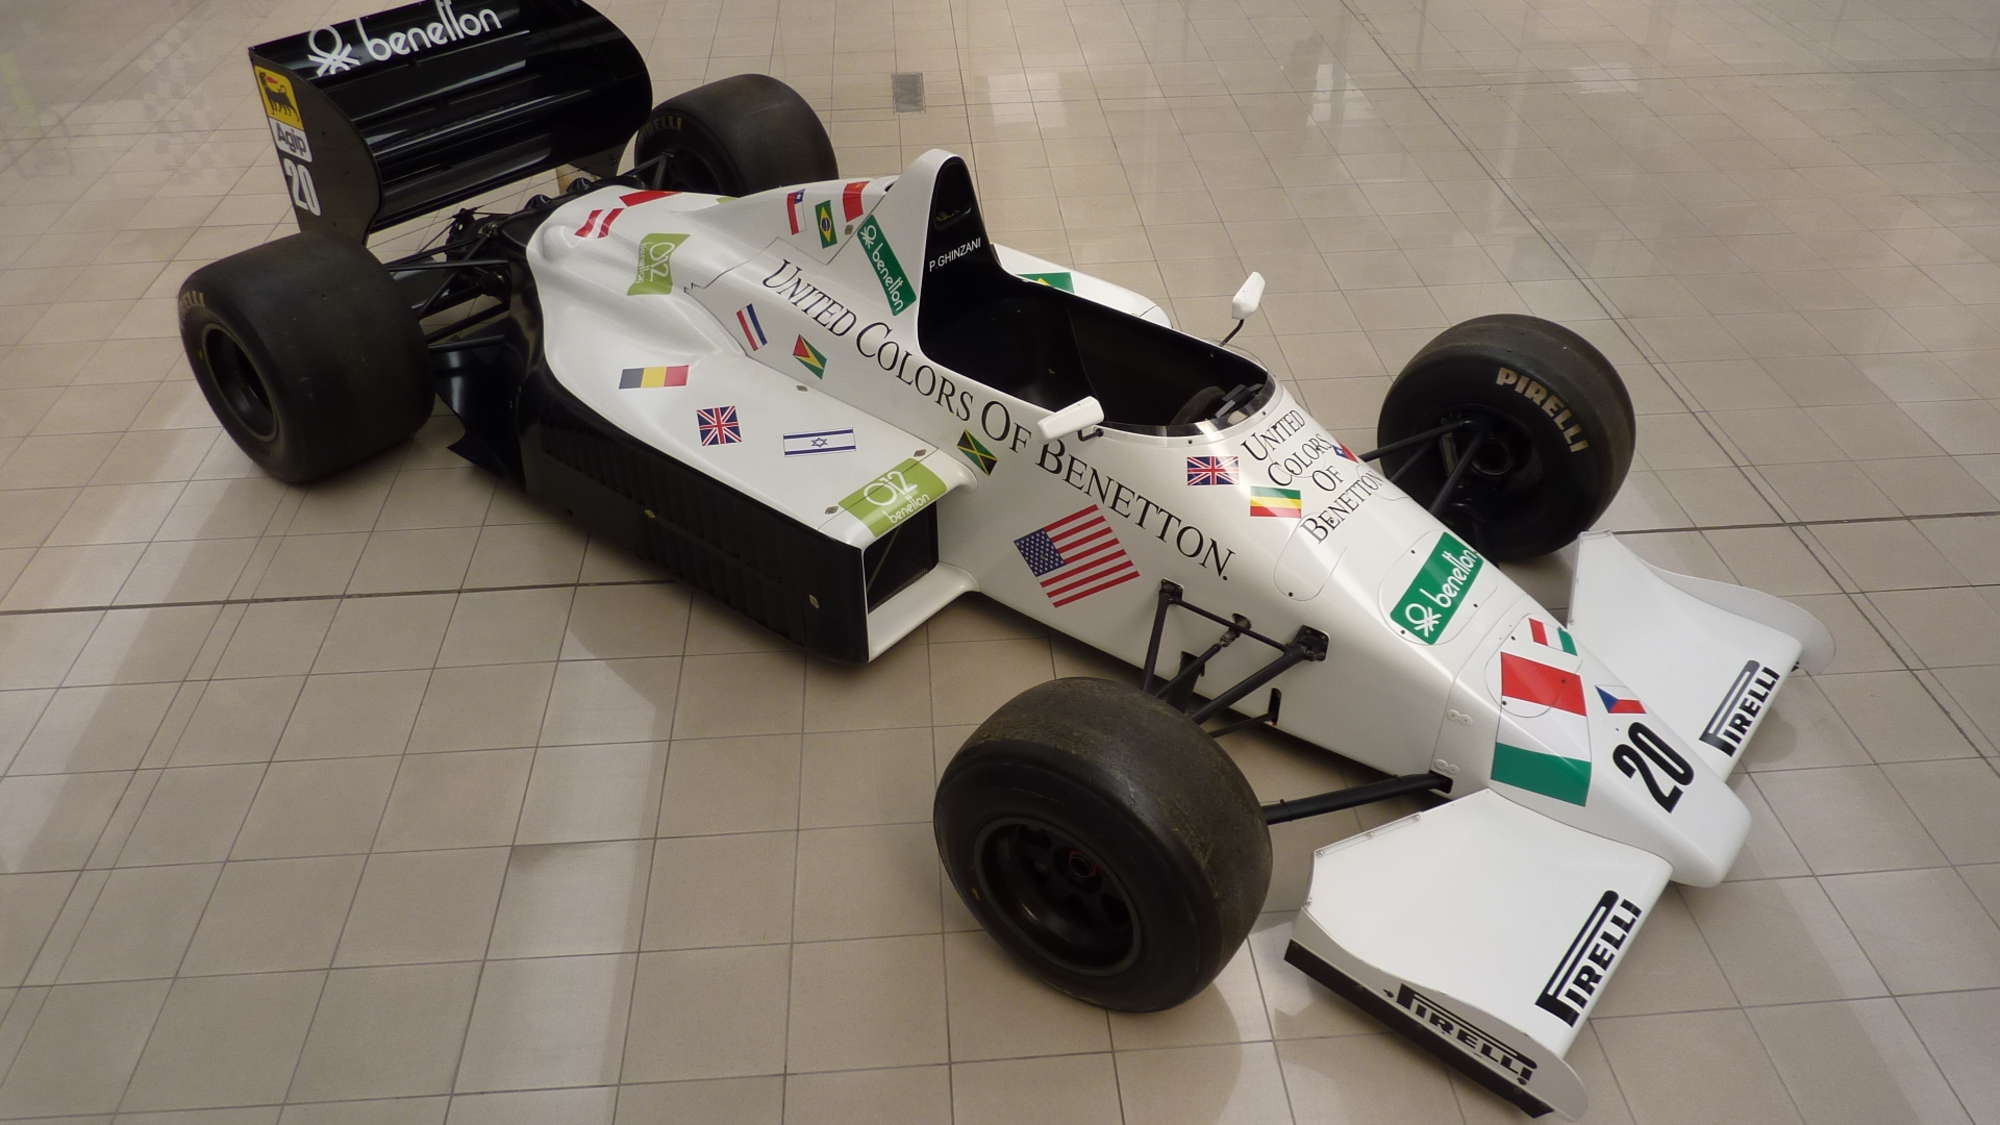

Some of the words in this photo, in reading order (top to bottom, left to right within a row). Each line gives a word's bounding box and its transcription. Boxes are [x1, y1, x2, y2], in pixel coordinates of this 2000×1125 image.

[356, 0, 502, 61] benetton
[276, 122, 306, 157] Agip
[283, 158, 321, 217] 20
[872, 242, 904, 312] benetton
[762, 259, 857, 337] UNITED
[856, 322, 973, 421] COLORS
[981, 401, 1032, 454] OF
[1241, 409, 1306, 461] UNITED
[1496, 367, 1589, 453] PIRELLI
[863, 470, 918, 506] 012
[1268, 433, 1333, 487] COLORS
[1312, 466, 1344, 492] OF
[882, 493, 930, 524] benetton
[1300, 470, 1383, 544] BENETTON
[1419, 549, 1479, 608] benetton
[1699, 660, 1780, 757] PIRELLI
[1613, 722, 1694, 813] 20
[1535, 890, 1642, 1028] PIRELLI
[1396, 984, 1537, 1081] PIRELLI
